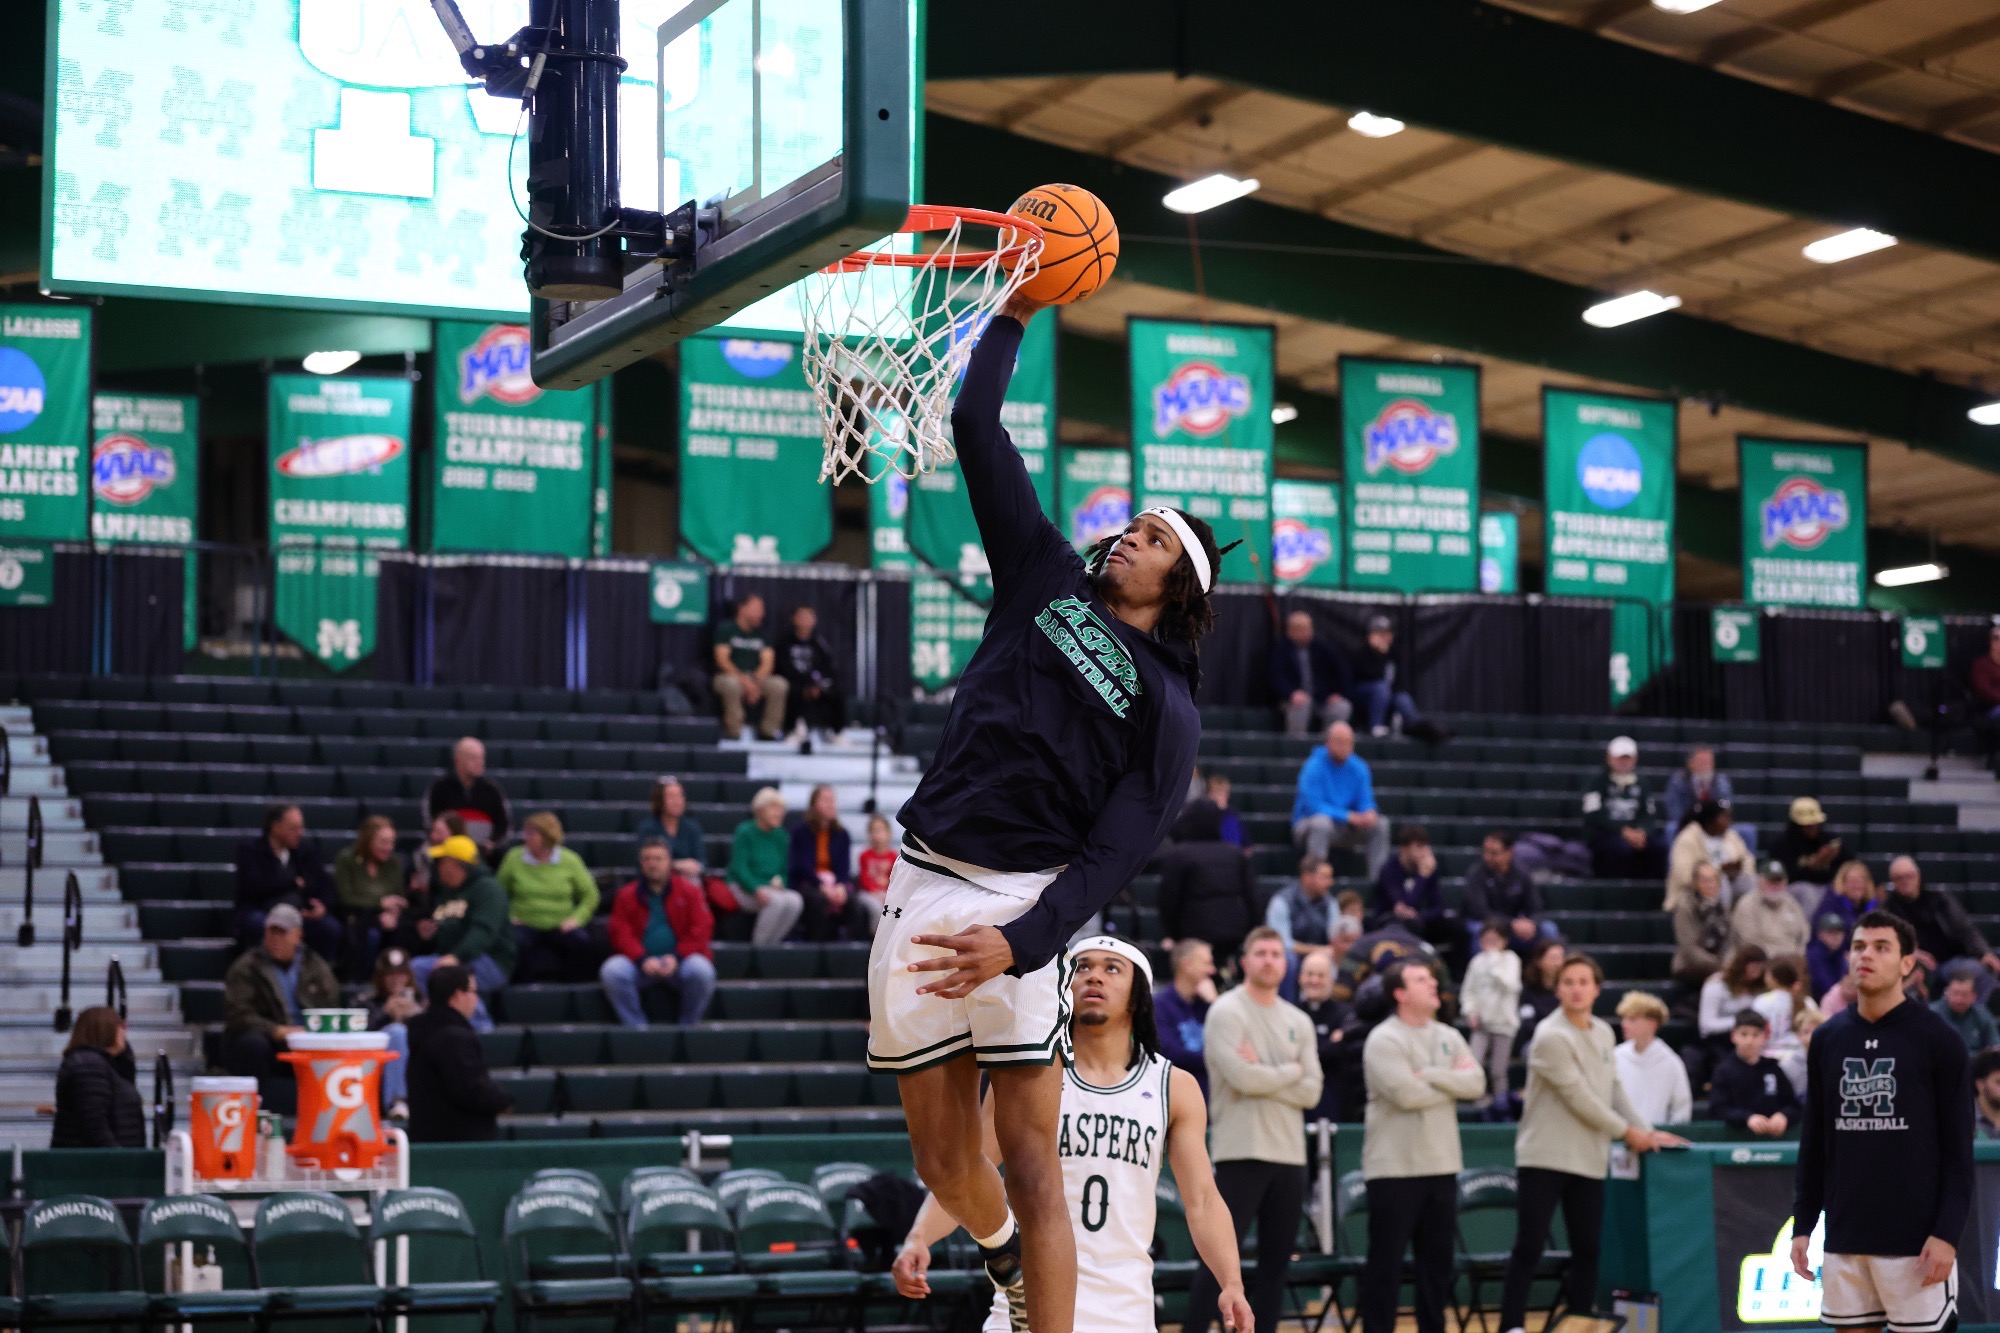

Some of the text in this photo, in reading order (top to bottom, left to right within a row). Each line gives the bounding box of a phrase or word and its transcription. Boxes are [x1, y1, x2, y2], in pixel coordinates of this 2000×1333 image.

[3, 316, 81, 339] LACROSSE
[1166, 334, 1237, 357] BASEBALL
[1376, 373, 1444, 396] BASEBALL
[1153, 373, 1252, 438] MAAC
[1577, 404, 1643, 430] SOFTBALL
[444, 411, 586, 443] TOURNAMENT
[446, 435, 583, 471] CHAMPIONS
[1142, 444, 1267, 470] TOURNAMENT
[1363, 413, 1459, 477] MAAC
[1772, 452, 1835, 475] SOFTBALL
[1144, 466, 1267, 496] CHAMPIONS
[1583, 465, 1642, 494] NCAA
[274, 498, 407, 529] CHAMPIONS
[1354, 502, 1471, 533] CHAMPIONS
[1552, 510, 1668, 541] TOURNAMENT
[1760, 490, 1848, 552] MAAC
[1552, 533, 1669, 565] APPEARANCES
[1752, 556, 1860, 583] TOURNAMENT
[1752, 577, 1860, 607] CHAMPIONS
[317, 618, 361, 660] M
[1049, 595, 1143, 696] JASPERS
[1035, 608, 1131, 718] BASKETBALL
[326, 1066, 365, 1109] G
[1841, 1056, 1896, 1117] M
[217, 1101, 242, 1126] G
[33, 1202, 115, 1228] MANHATTAN
[151, 1200, 230, 1225] MANHATTAN
[266, 1199, 344, 1224] MANHATTAN
[382, 1197, 460, 1222] MANHATTAN
[518, 1194, 593, 1218] MANHATTAN
[642, 1190, 718, 1215] MANHATTAN
[747, 1189, 822, 1213] MANHATTAN
[1081, 1174, 1109, 1232] 0
